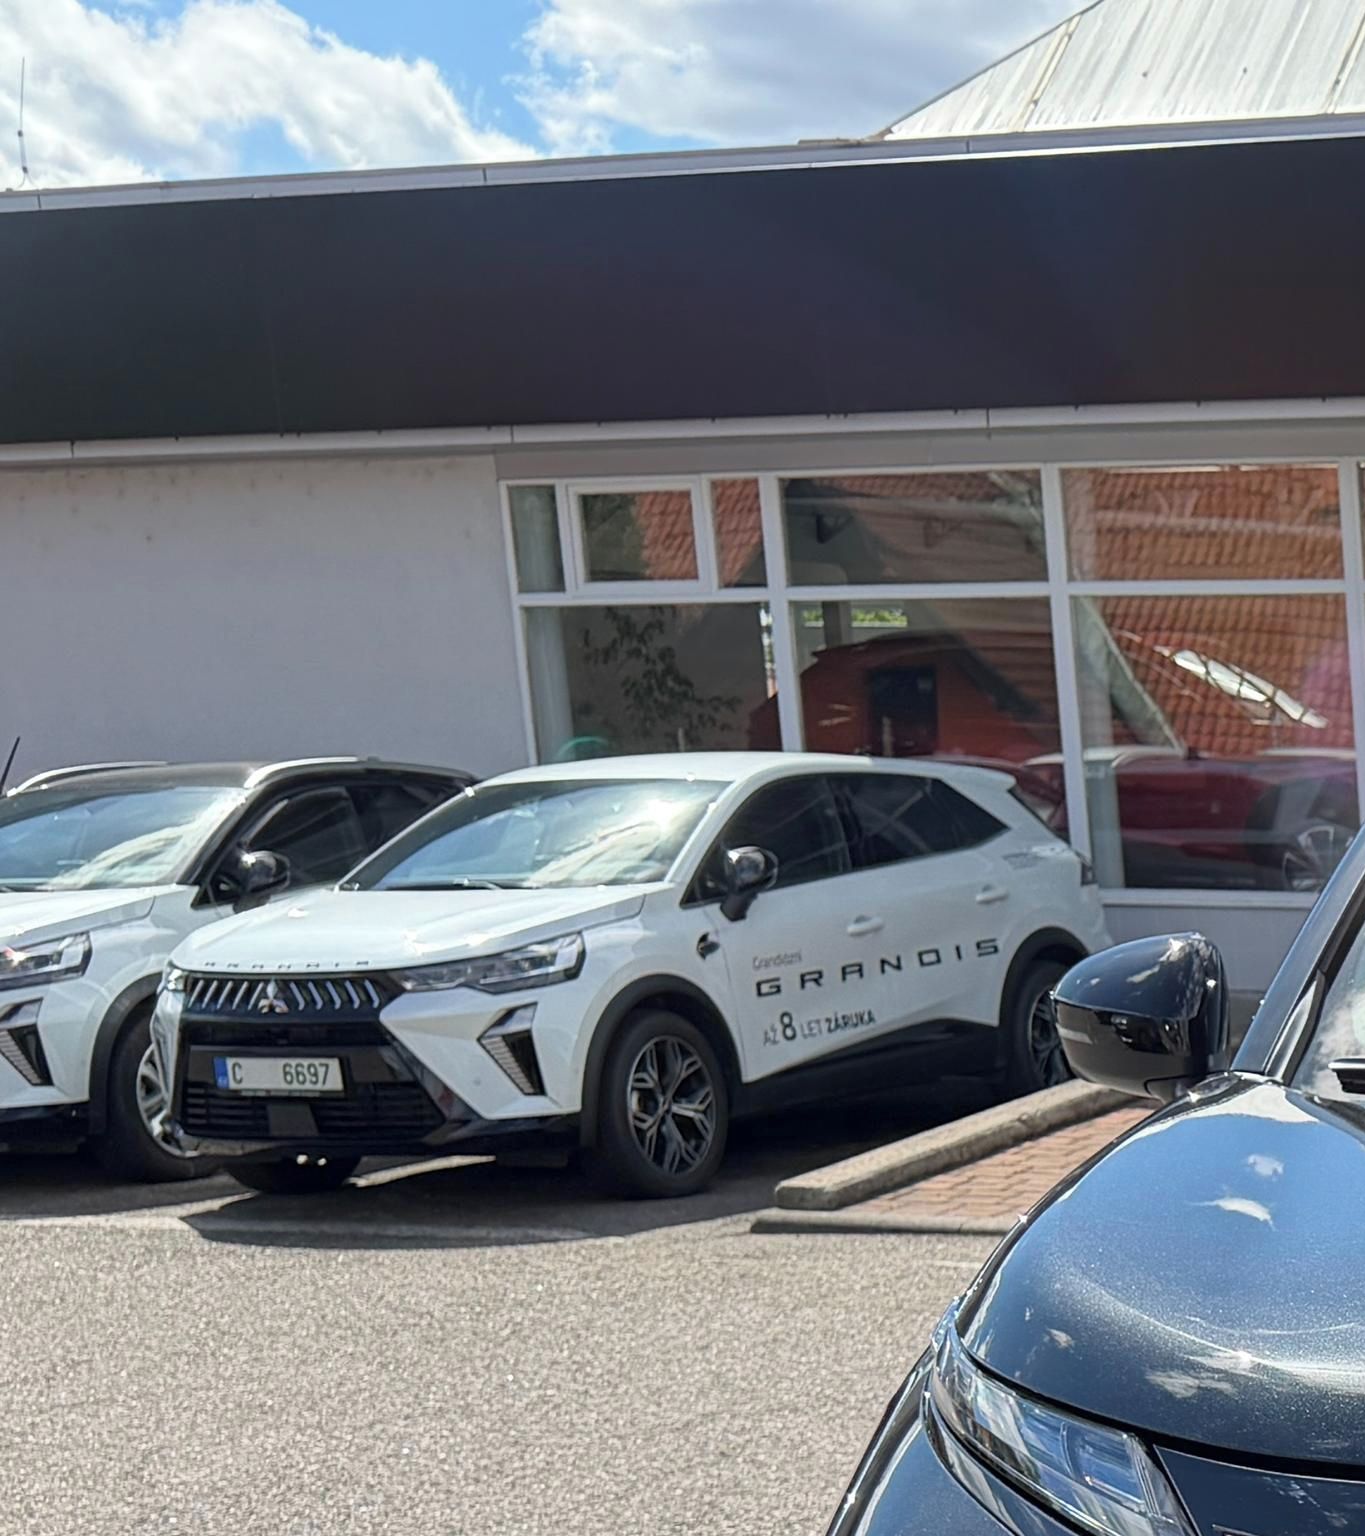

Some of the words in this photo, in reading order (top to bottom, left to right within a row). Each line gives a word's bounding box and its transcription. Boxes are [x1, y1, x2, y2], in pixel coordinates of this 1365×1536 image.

[755, 938, 999, 998] GRANDIS
[779, 1010, 797, 1041] 8
[800, 1018, 822, 1039] LET
[825, 1009, 876, 1034] ZÁRUKA
[231, 1062, 243, 1085] C
[282, 1062, 330, 1086] 6697
